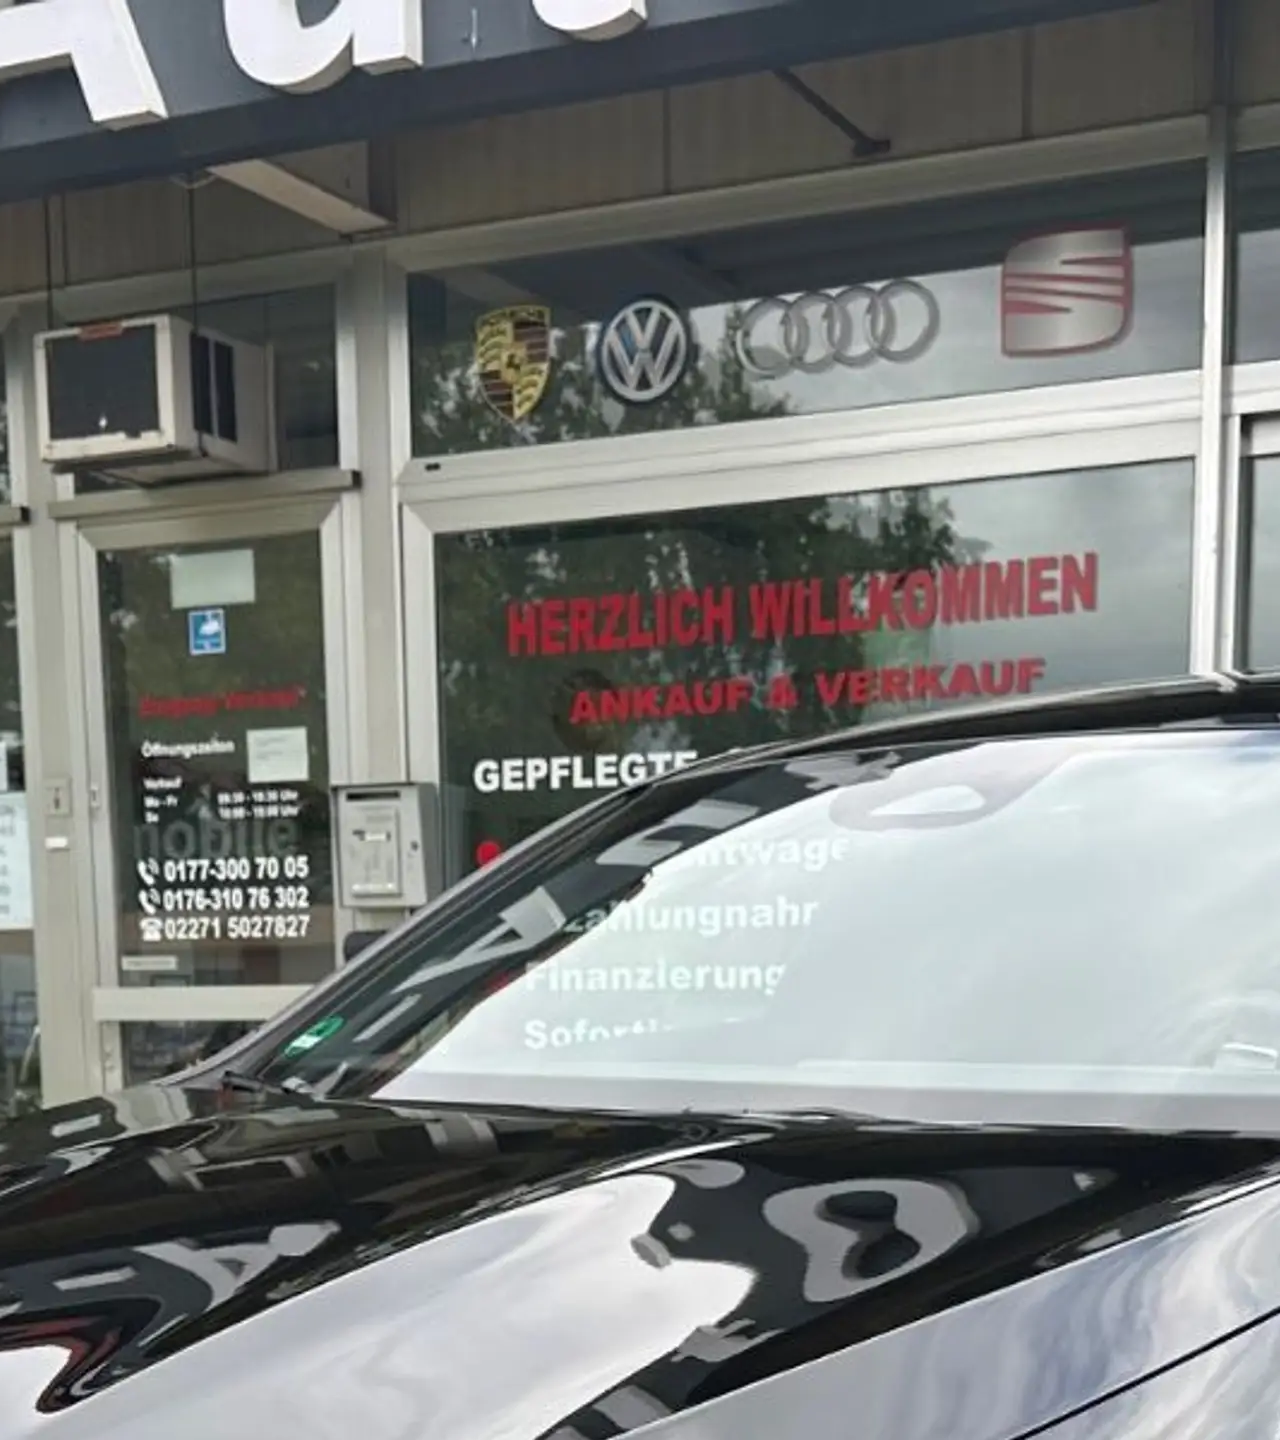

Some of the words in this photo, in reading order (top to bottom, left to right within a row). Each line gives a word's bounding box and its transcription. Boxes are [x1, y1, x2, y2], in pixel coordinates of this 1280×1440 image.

[507, 585, 734, 657] HERZLICH
[749, 552, 1098, 640] WILLKOMMEN
[569, 676, 754, 726] ANKAUF
[767, 675, 799, 711] &
[816, 657, 1047, 706] VERKAUF
[163, 858, 250, 882] 0177-300
[254, 857, 279, 880] 70
[283, 855, 310, 878] 05
[162, 887, 243, 912] 0176-310
[247, 887, 270, 909] 76
[274, 886, 310, 909] 302
[164, 916, 221, 940] 02271
[226, 914, 310, 939] 5027827
